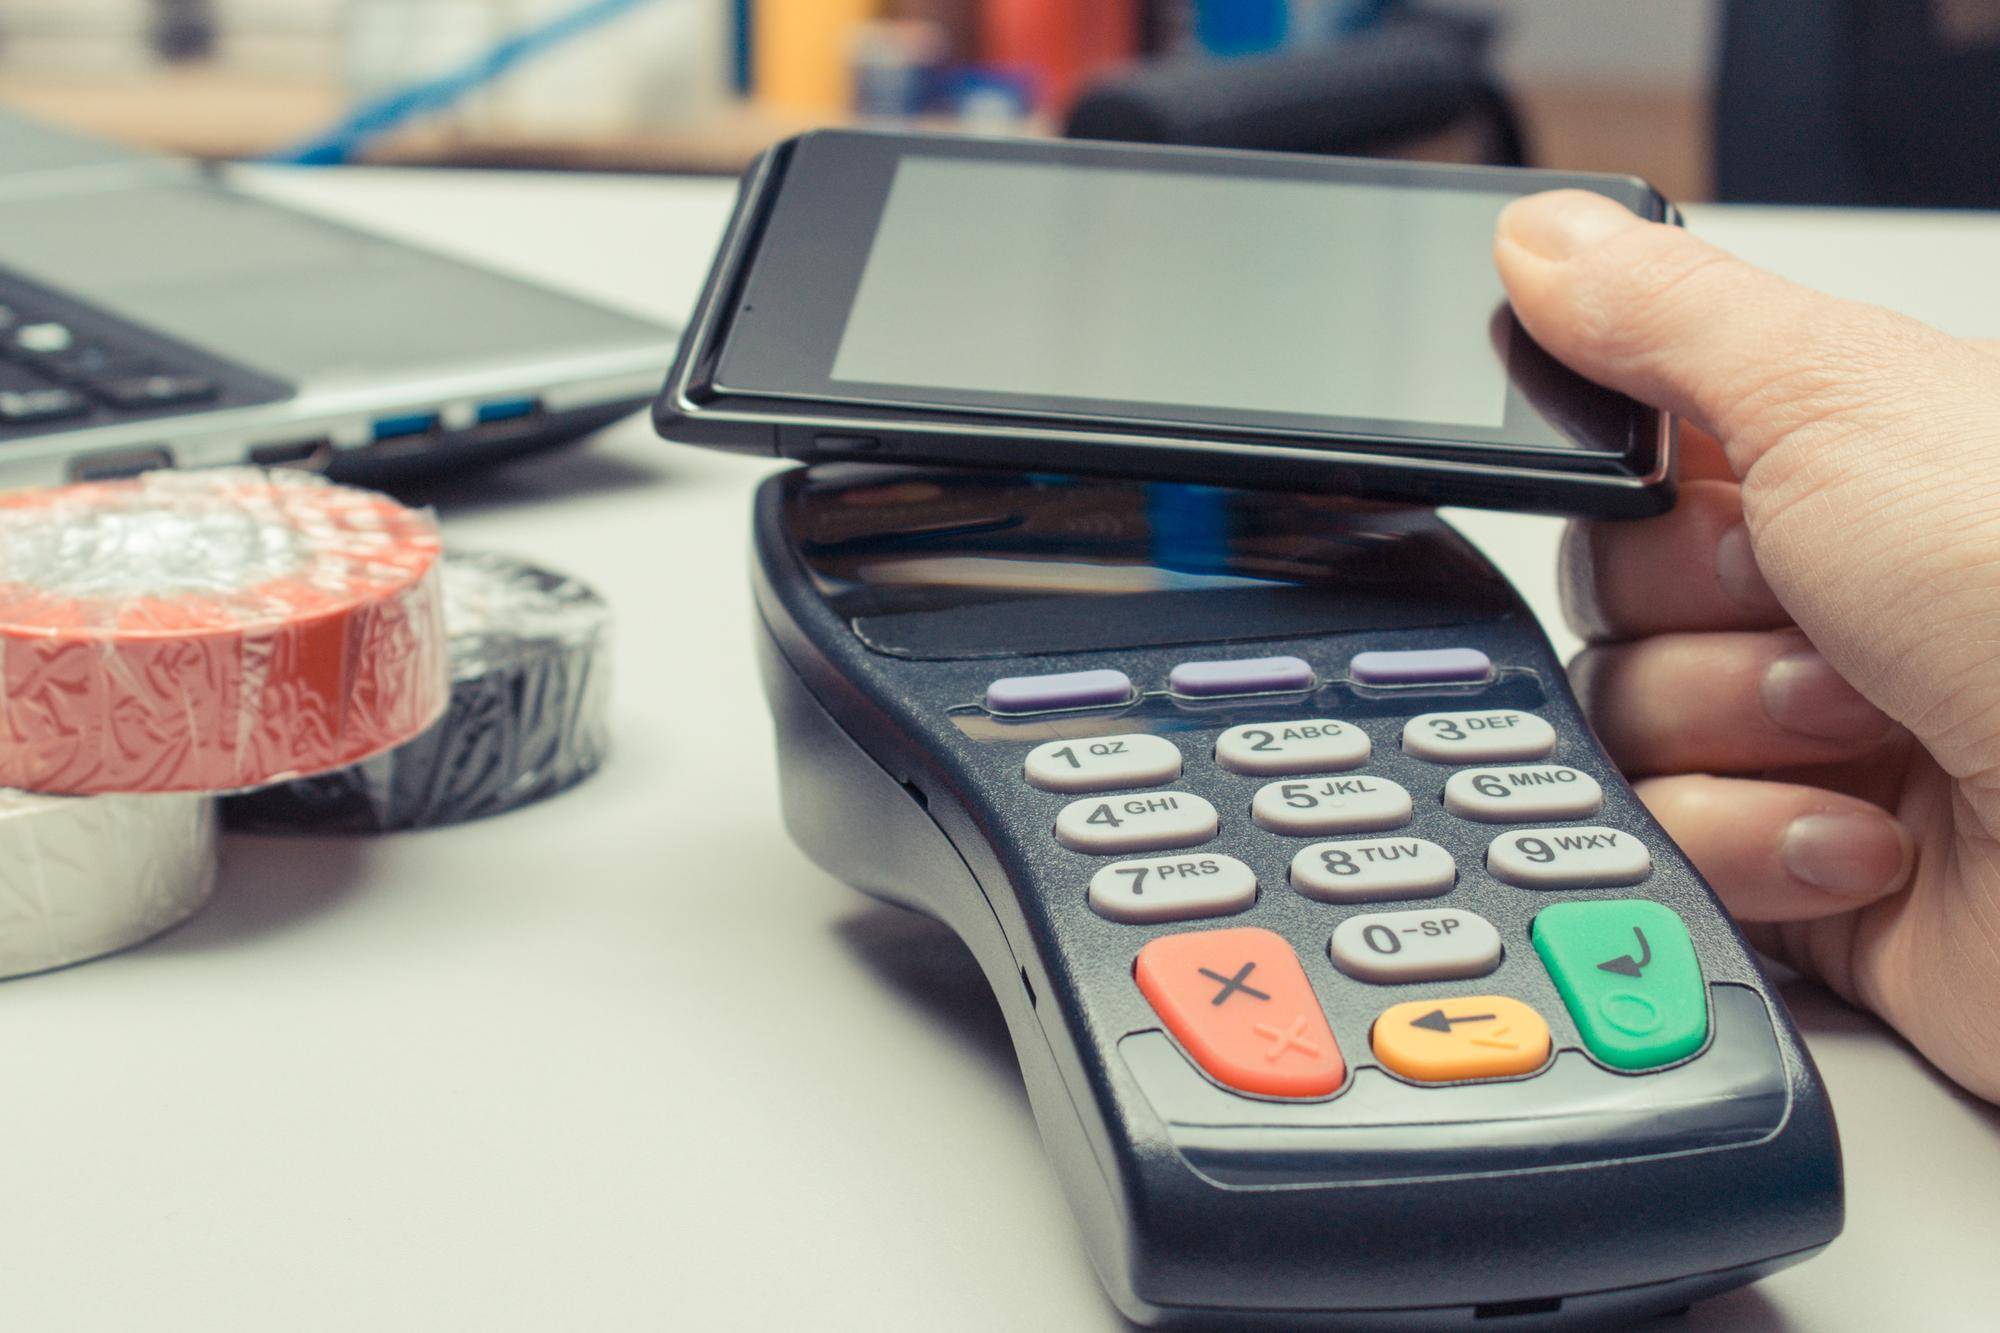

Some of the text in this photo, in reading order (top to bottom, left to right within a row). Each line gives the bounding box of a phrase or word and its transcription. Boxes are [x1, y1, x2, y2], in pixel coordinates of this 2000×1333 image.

[1242, 724, 1342, 751] 2 ABC
[1428, 715, 1520, 741] 3 DEF
[1051, 741, 1129, 768] 1 QZ
[1281, 780, 1377, 808] 5 JKL
[1471, 769, 1577, 798] 6 MNO
[1086, 797, 1179, 828] 4 GHI
[1320, 843, 1419, 876] 8 TUV
[1515, 833, 1617, 863] 9 WXY
[1115, 860, 1220, 895] 7 PRS
